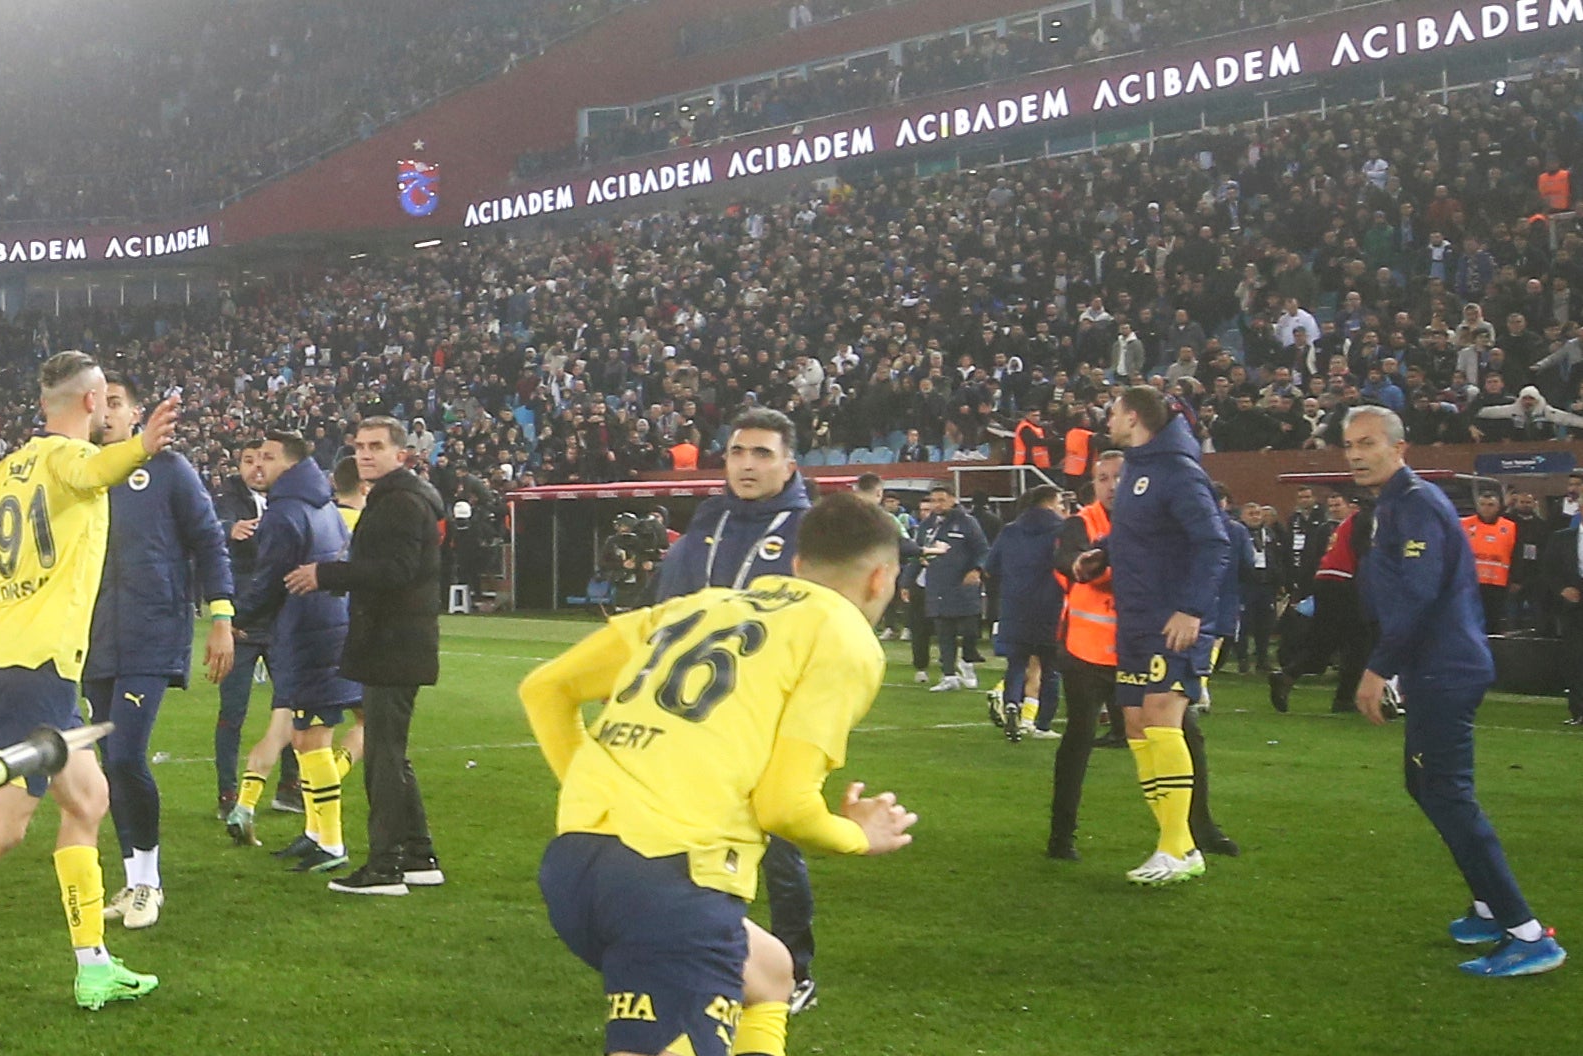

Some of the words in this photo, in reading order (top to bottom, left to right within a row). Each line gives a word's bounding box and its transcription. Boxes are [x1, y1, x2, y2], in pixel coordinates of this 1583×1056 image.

[465, 185, 573, 226] ACIBADEM
[587, 158, 711, 203] ACIBADEM
[728, 126, 873, 177] ACIBADEM
[896, 88, 1068, 146] ACIBADEM
[1093, 43, 1300, 109] ACIBADEM
[106, 226, 208, 257] ACIBADEM
[617, 609, 768, 723] 16
[1148, 653, 1168, 683] 9
[598, 720, 665, 750] MERT
